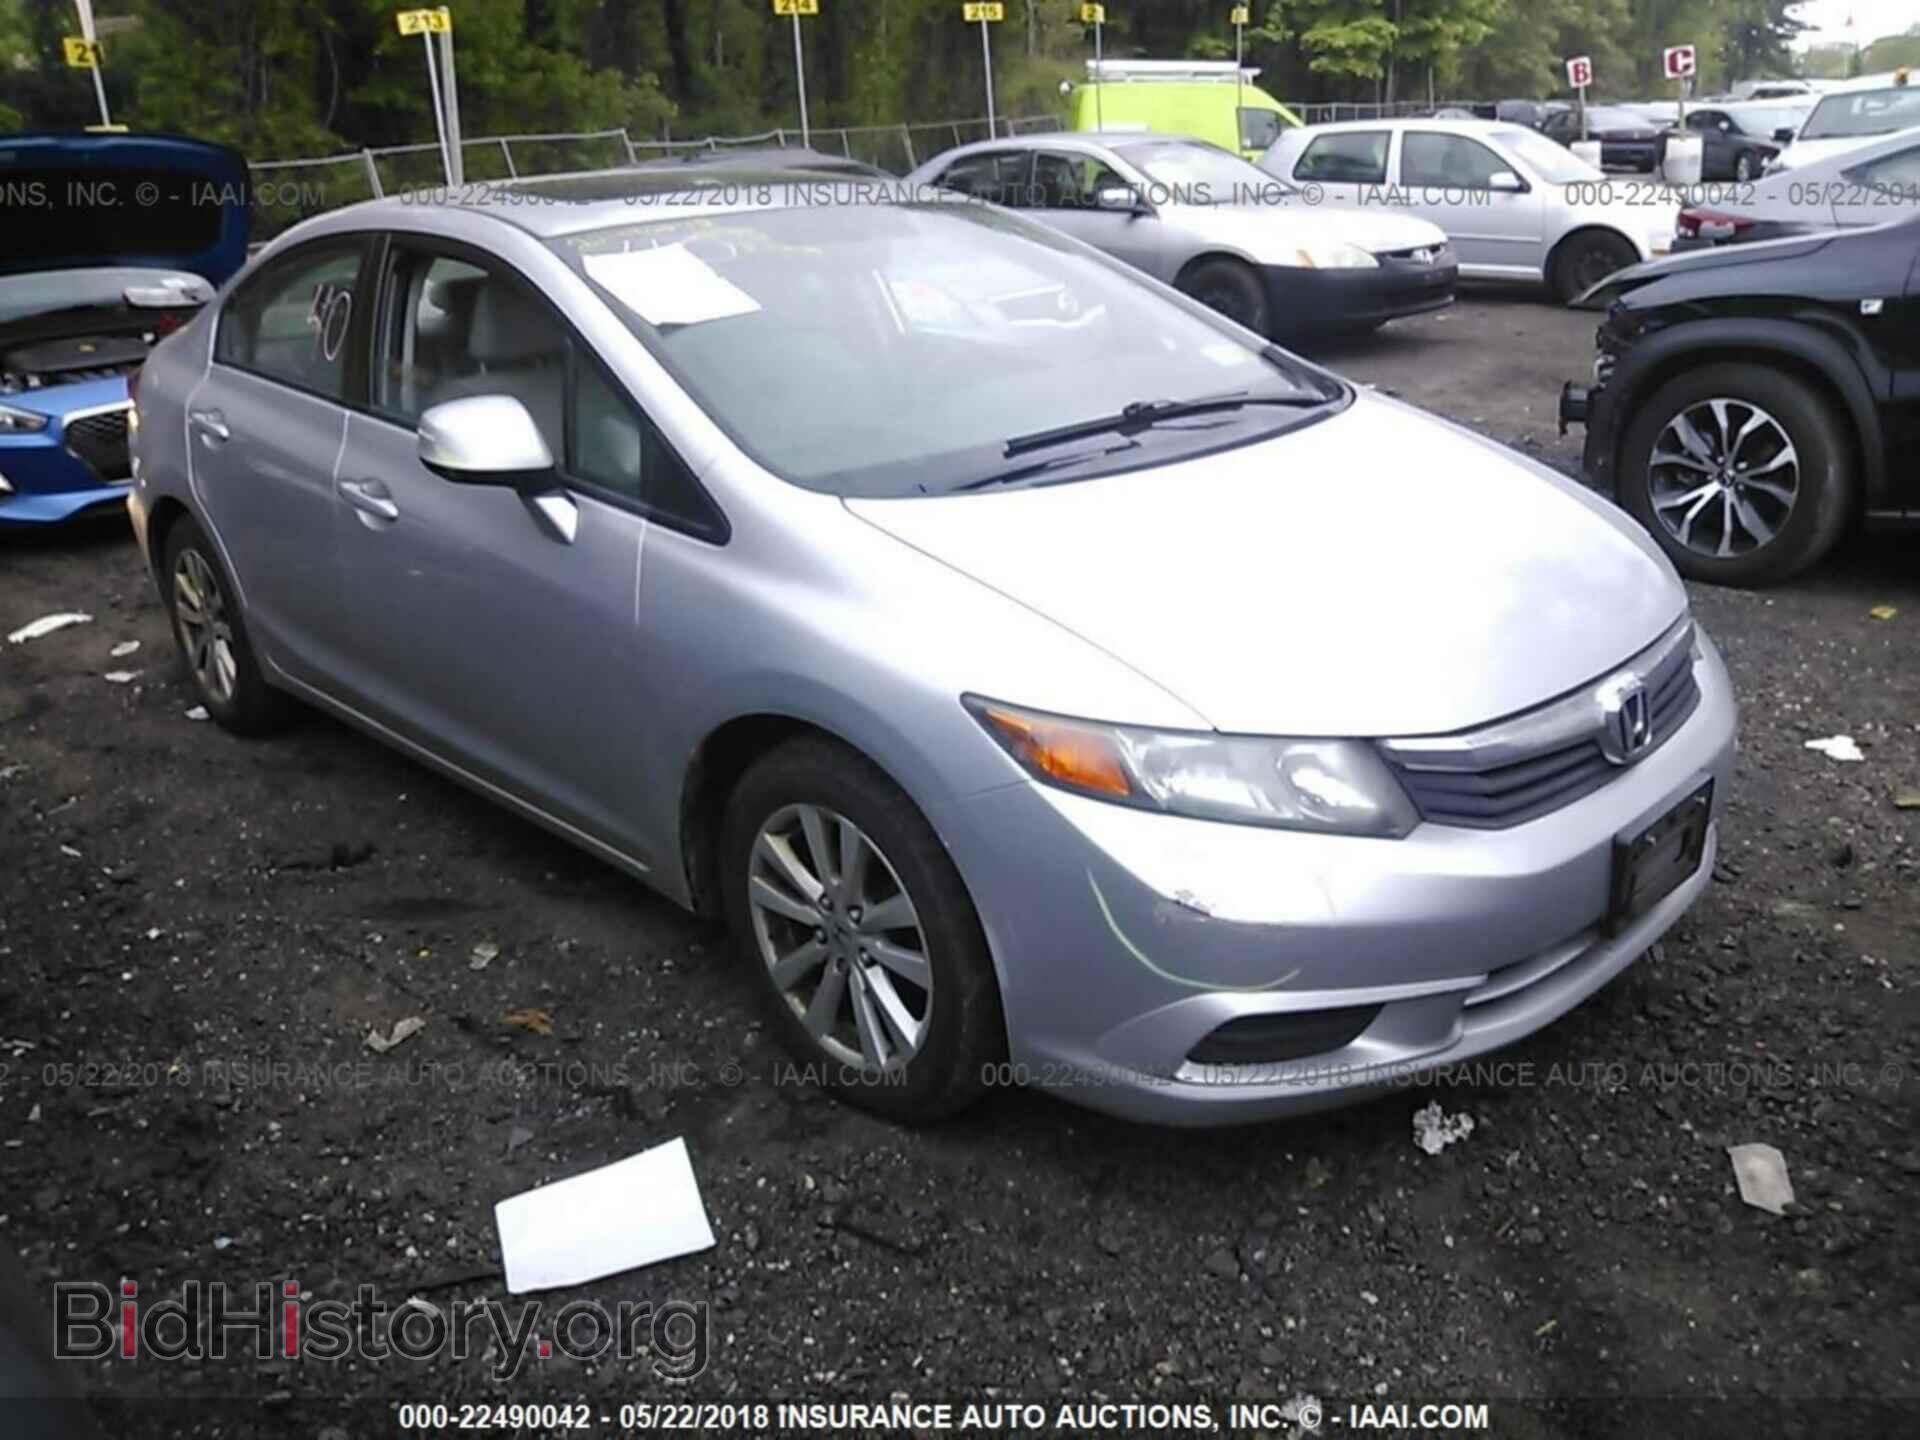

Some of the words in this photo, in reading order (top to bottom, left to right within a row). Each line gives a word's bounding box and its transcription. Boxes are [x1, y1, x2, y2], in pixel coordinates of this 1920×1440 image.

[407, 13, 445, 29] 213
[1573, 62, 1589, 84] B
[1668, 50, 1693, 74] C
